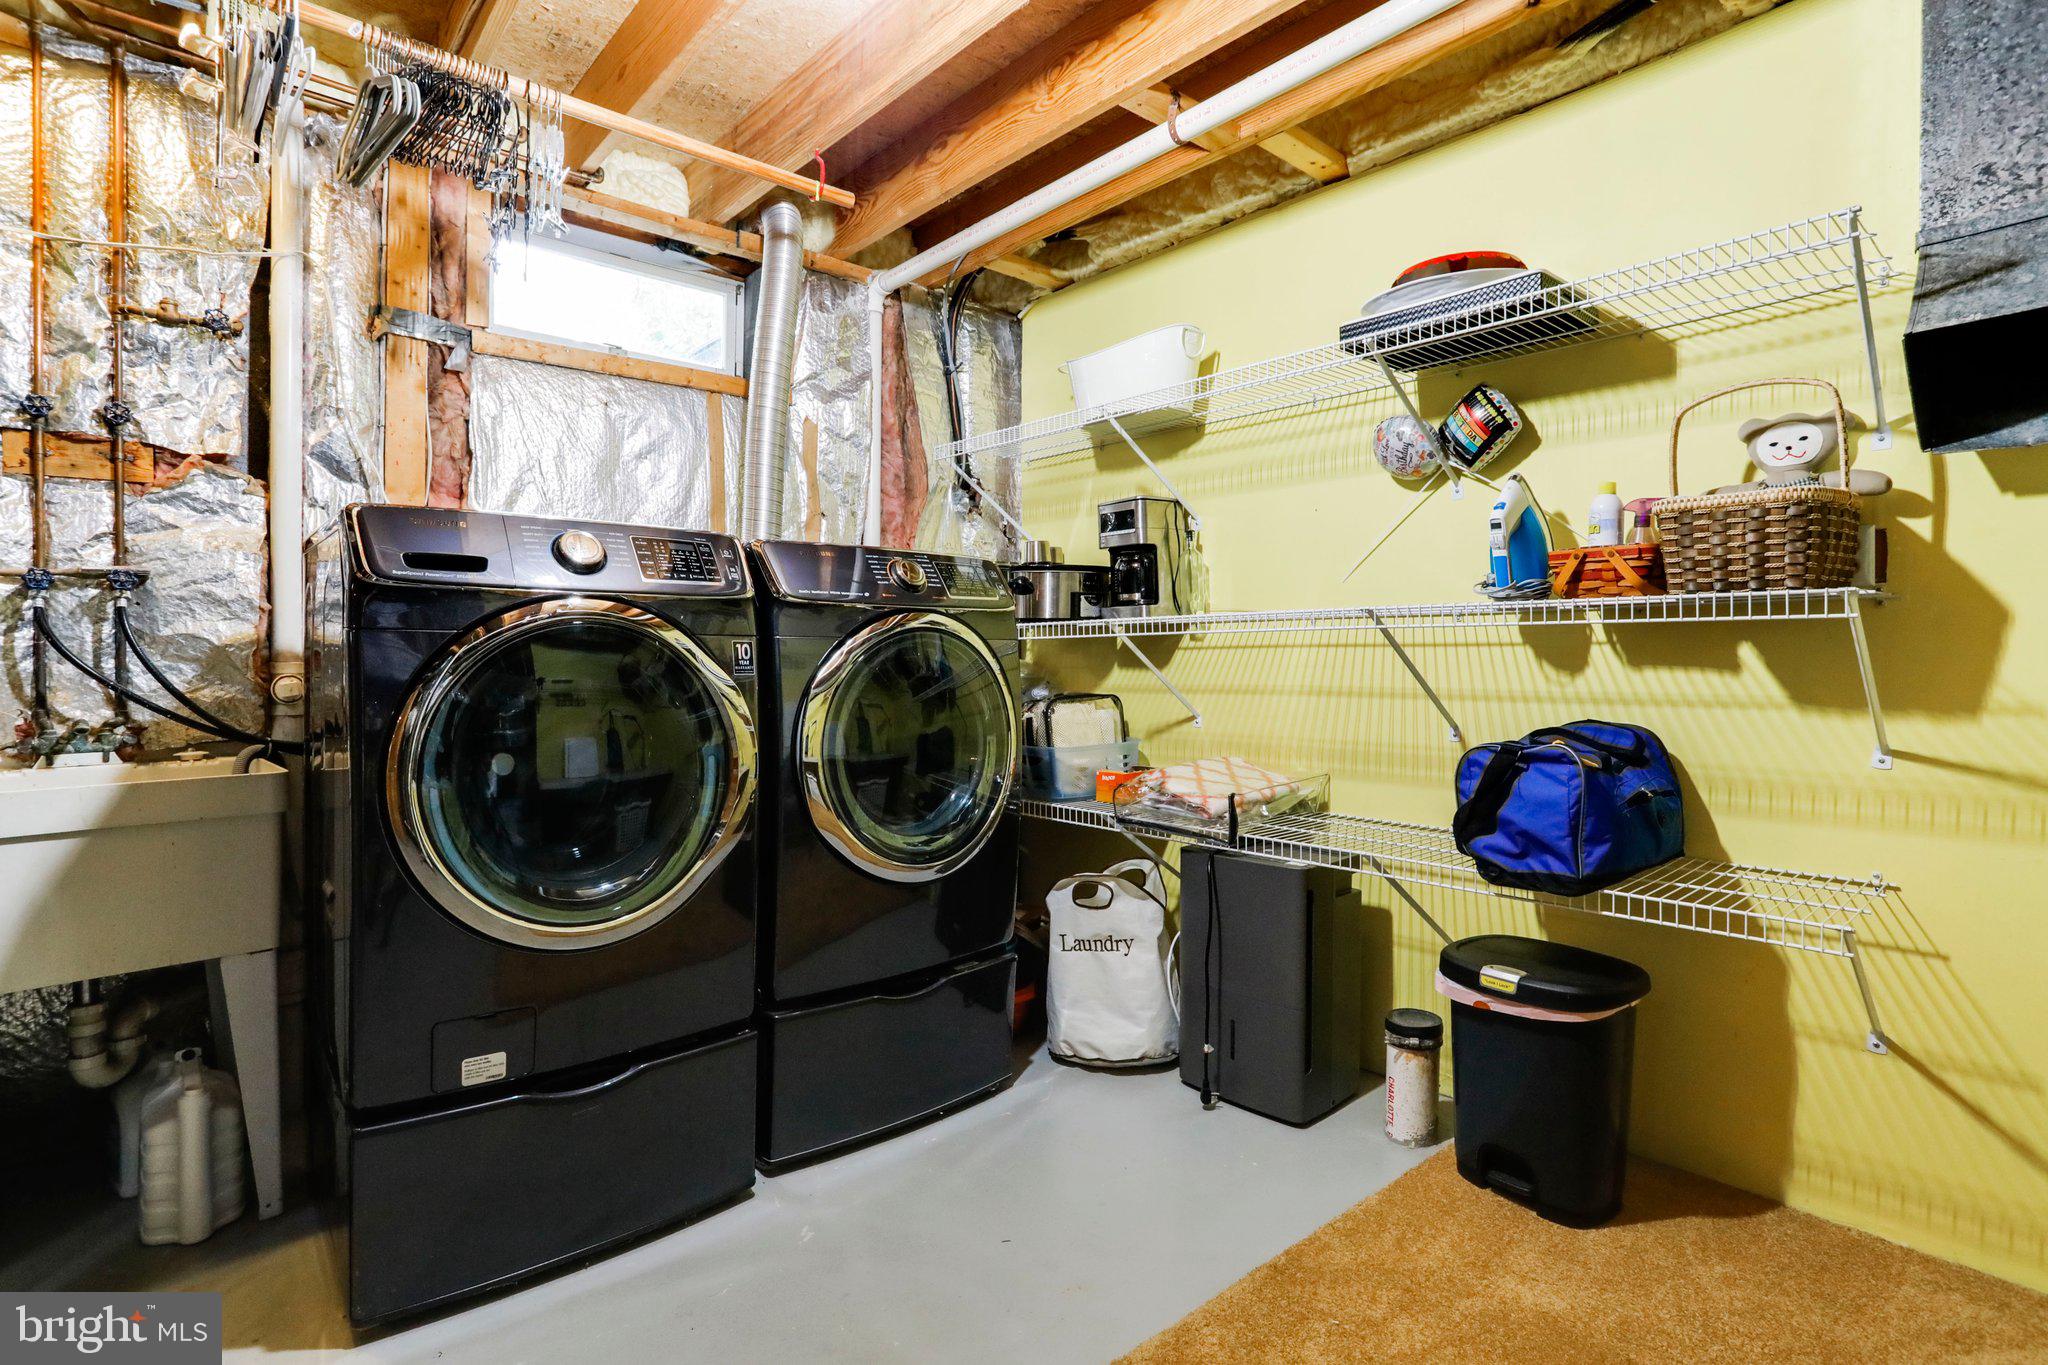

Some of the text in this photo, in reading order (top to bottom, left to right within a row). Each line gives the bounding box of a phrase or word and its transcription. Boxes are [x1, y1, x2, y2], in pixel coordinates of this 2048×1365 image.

[735, 643, 751, 660] 10
[1059, 933, 1135, 957] Laundry
[1386, 1076, 1395, 1127] CHARLOTTE
